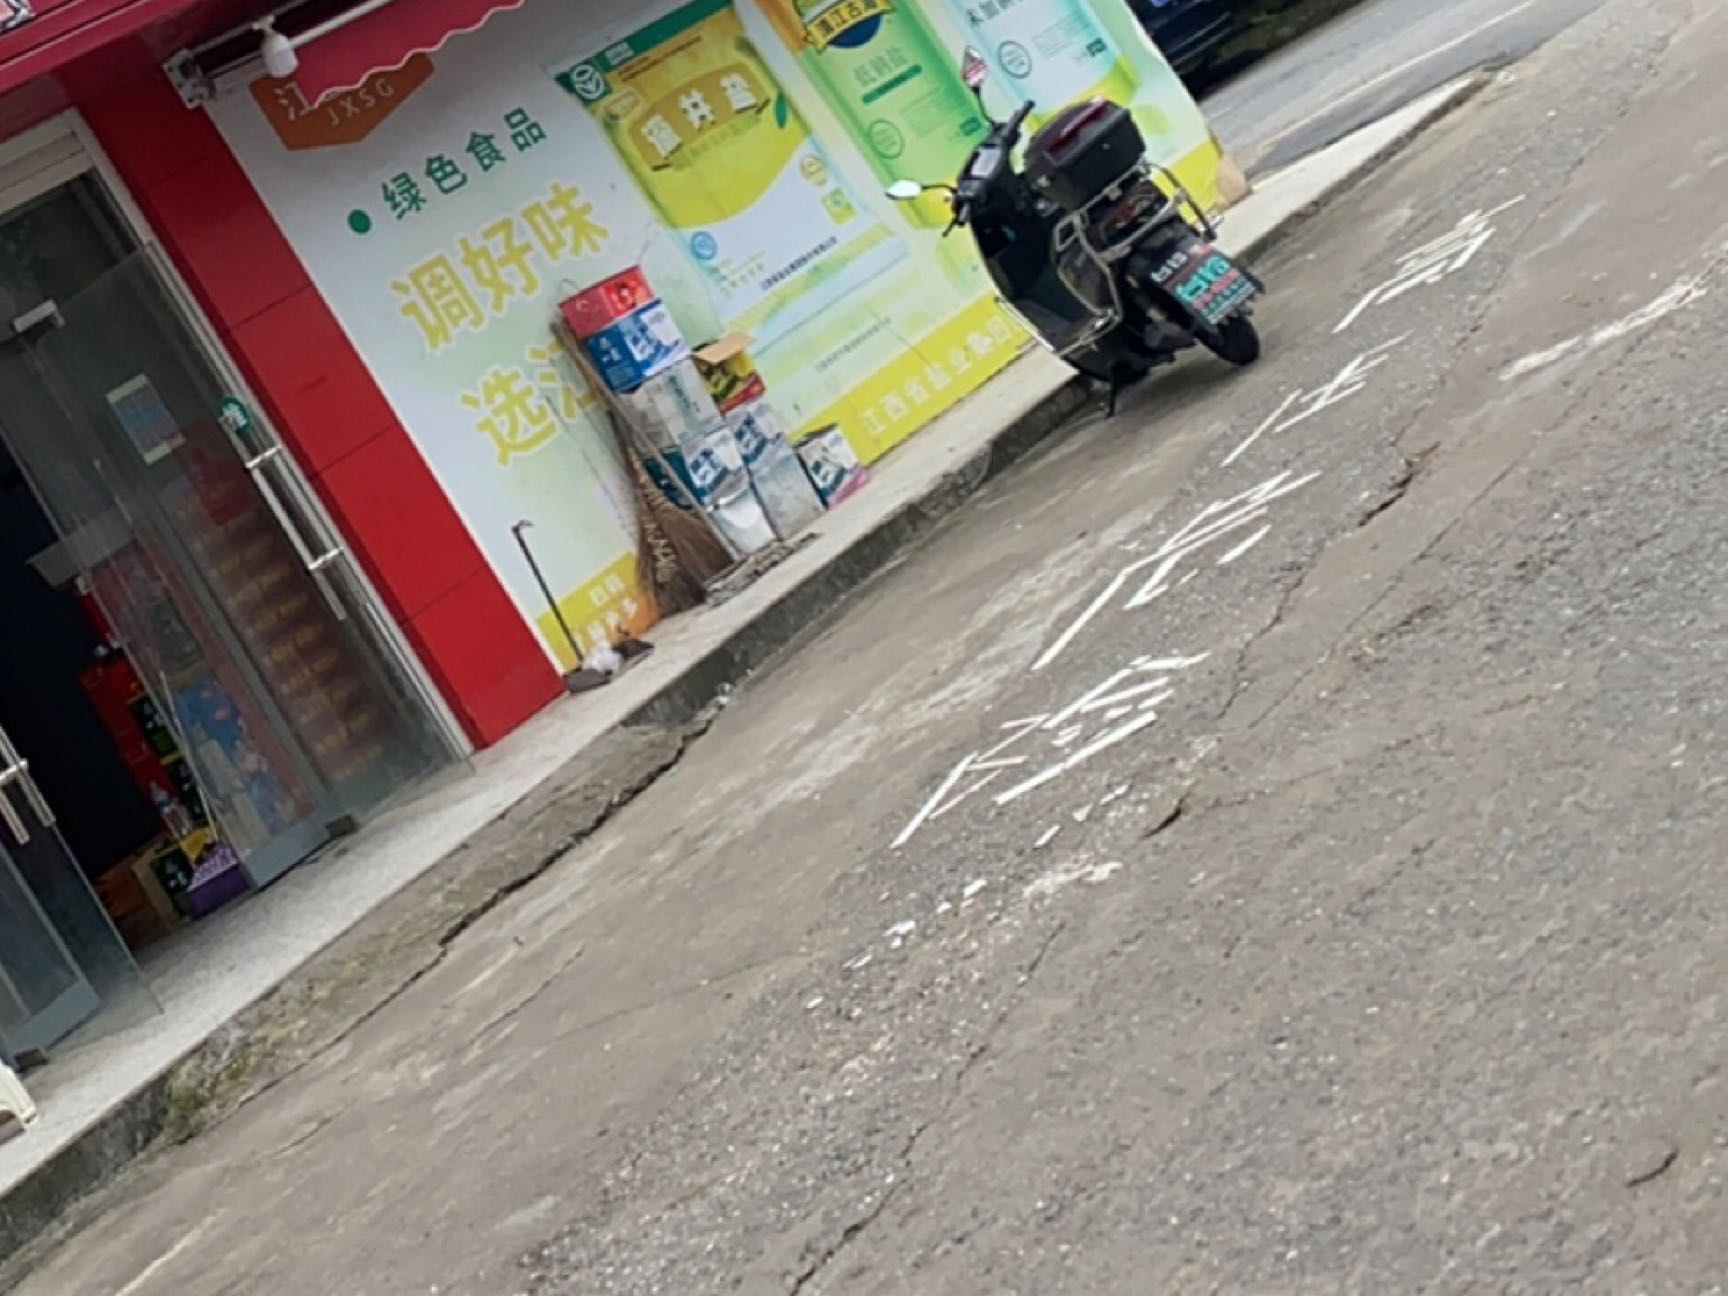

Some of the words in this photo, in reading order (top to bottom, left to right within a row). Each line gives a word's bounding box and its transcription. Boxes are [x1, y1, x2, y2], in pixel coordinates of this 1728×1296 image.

[324, 75, 396, 128] JXSG
[381, 106, 548, 223] 绿色食品
[390, 180, 610, 355] 调好味
